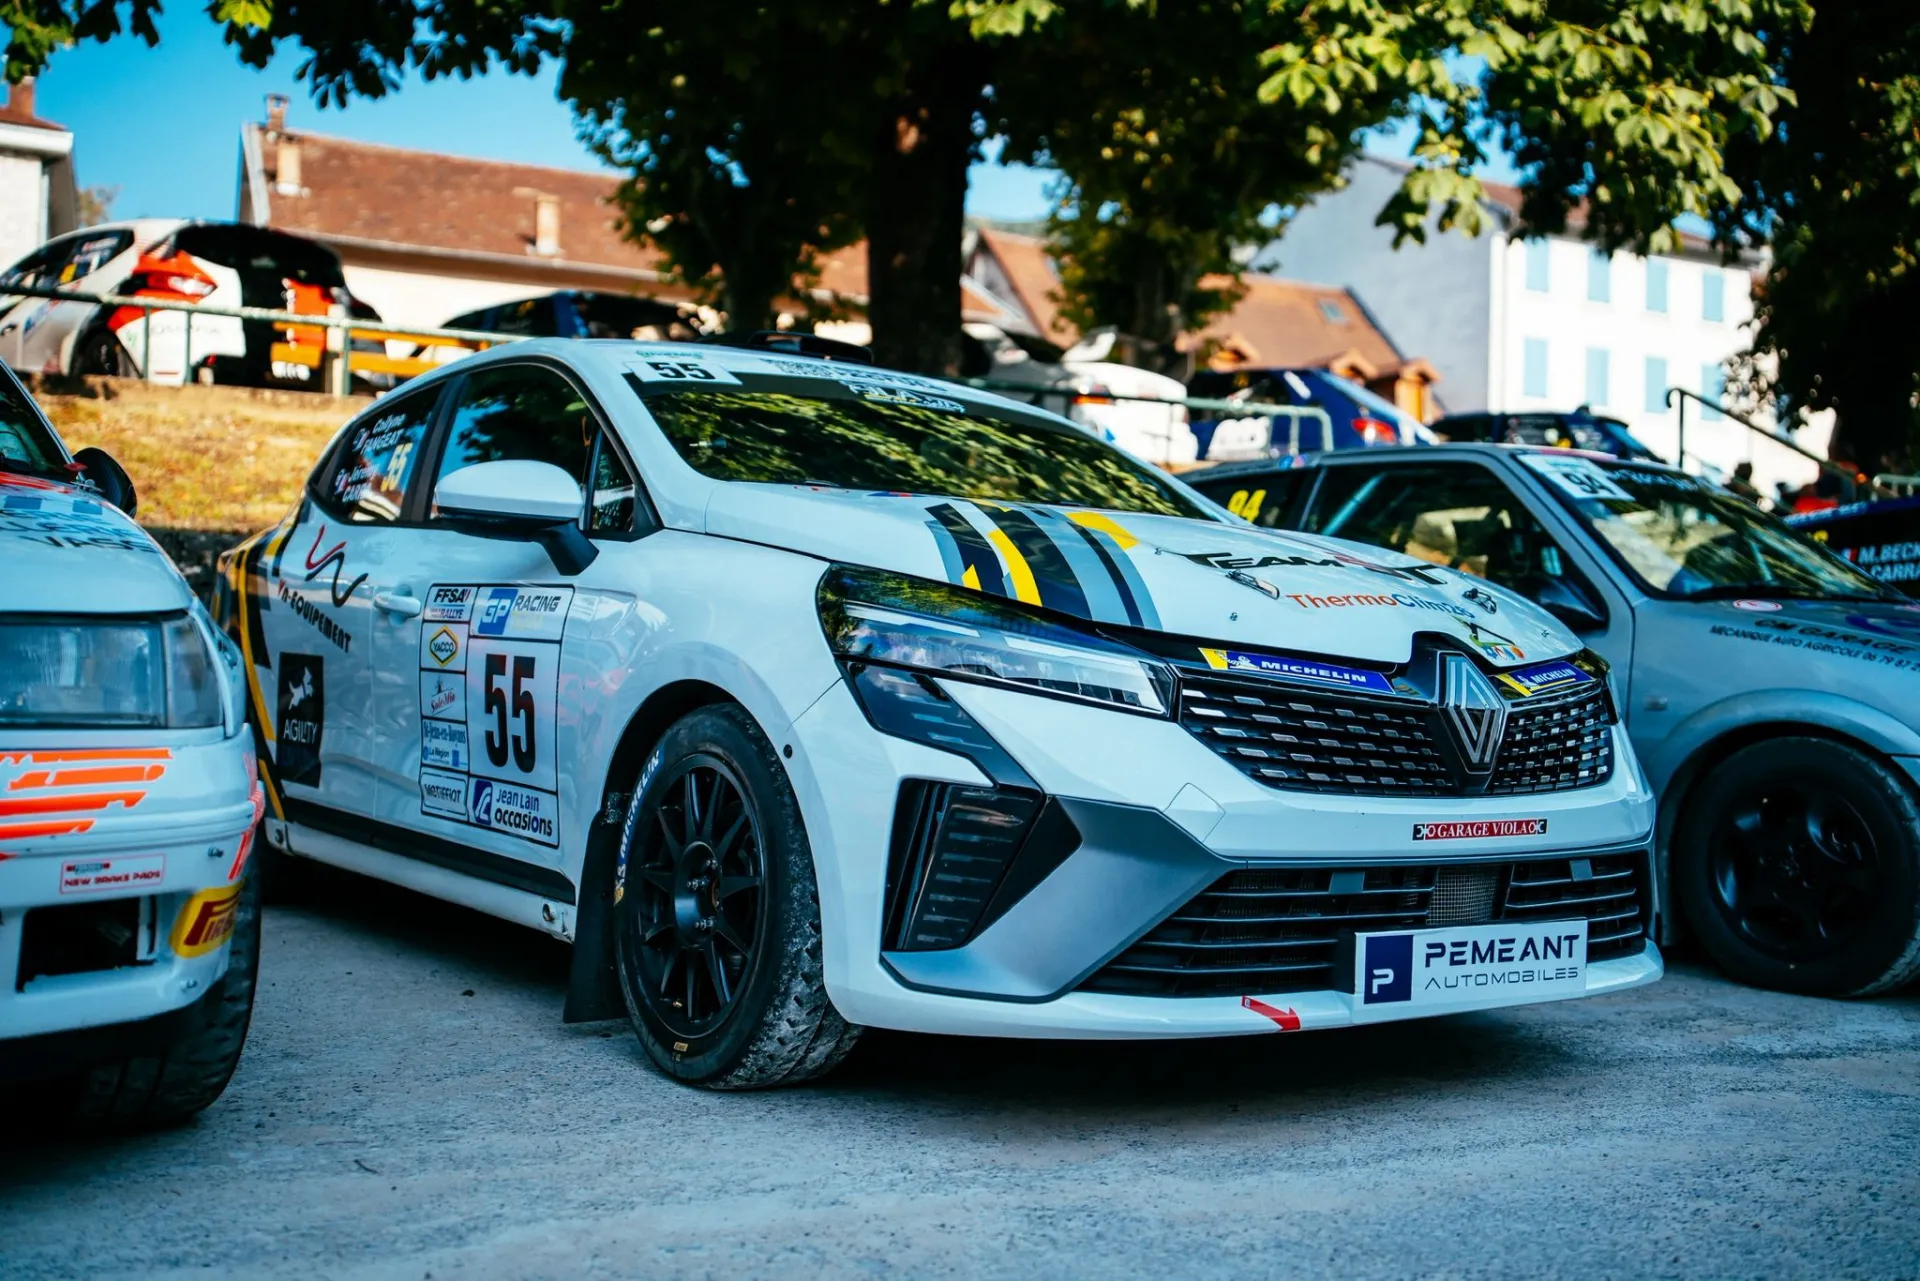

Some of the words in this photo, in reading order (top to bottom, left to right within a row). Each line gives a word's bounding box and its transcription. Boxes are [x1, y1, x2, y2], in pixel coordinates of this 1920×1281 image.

[646, 361, 715, 380] 55
[380, 442, 413, 492] 55
[1227, 488, 1267, 523] 94
[433, 588, 466, 604] FFSA
[511, 594, 562, 613] RACING
[481, 598, 512, 624] GP
[433, 641, 454, 654] YACCO
[1261, 660, 1368, 683] MICHELIN
[1531, 667, 1576, 686] MICHELIN
[484, 652, 536, 774] 55
[282, 718, 318, 745] AGILITY
[496, 788, 520, 808] Jean
[519, 792, 540, 812] Lain
[494, 807, 553, 838] occasions
[1437, 822, 1490, 838] GARAGE
[1492, 820, 1530, 835] VIOLA
[63, 878, 91, 888] NEW
[132, 869, 161, 880] PADS
[1424, 934, 1580, 969] PEMEANT
[1372, 967, 1395, 995] P
[1424, 966, 1579, 991] AUTOMOBILES
